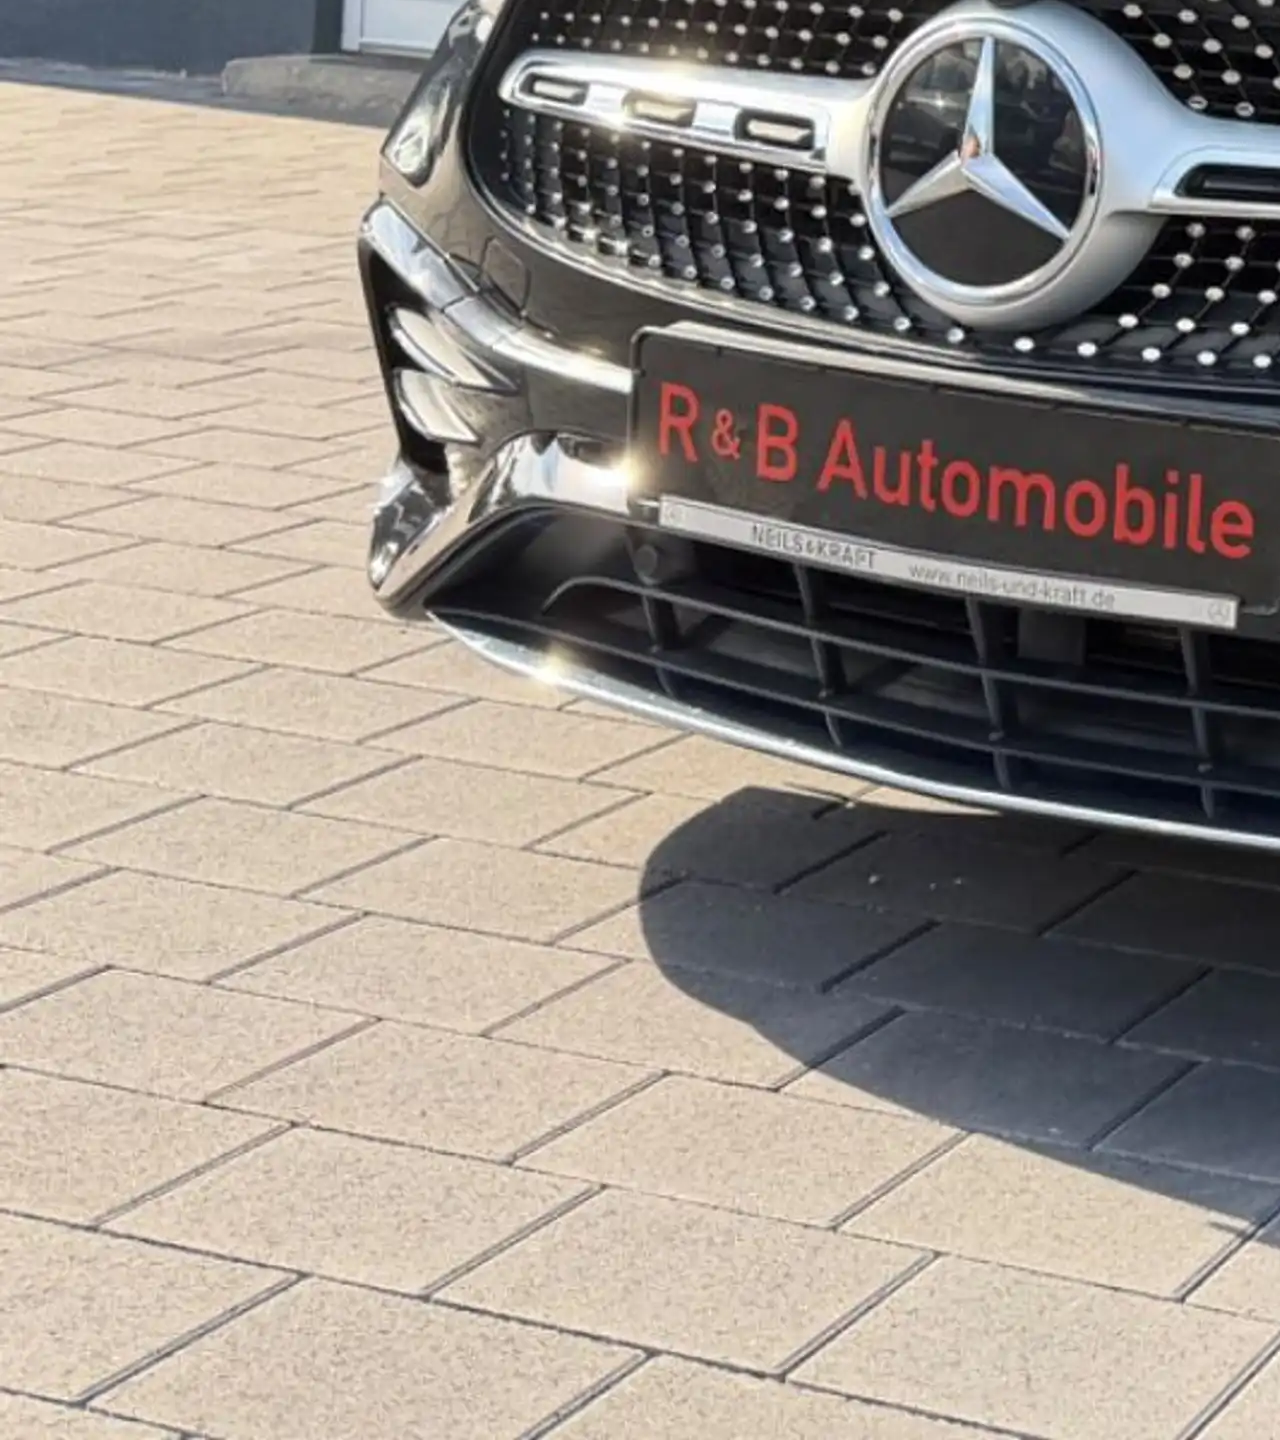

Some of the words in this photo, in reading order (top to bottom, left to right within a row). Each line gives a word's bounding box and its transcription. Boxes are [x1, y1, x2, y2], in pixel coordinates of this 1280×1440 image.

[658, 381, 698, 462] R
[711, 408, 741, 460] &
[756, 403, 799, 484] B
[817, 418, 1255, 560] Automobile
